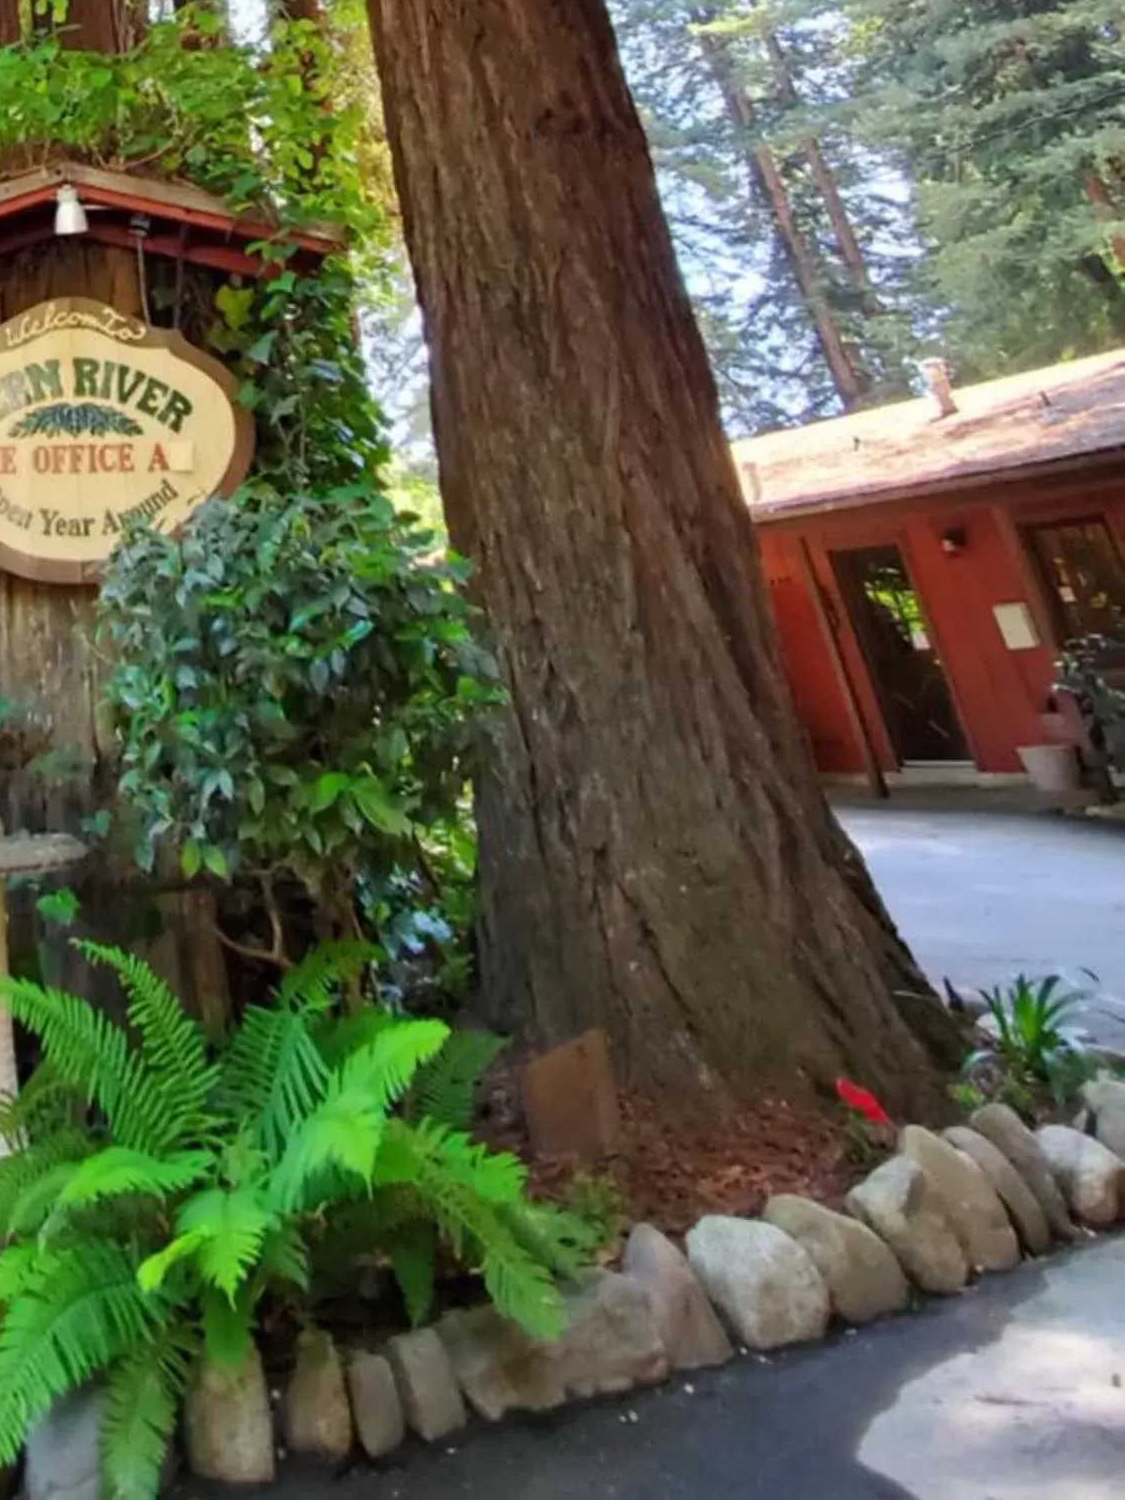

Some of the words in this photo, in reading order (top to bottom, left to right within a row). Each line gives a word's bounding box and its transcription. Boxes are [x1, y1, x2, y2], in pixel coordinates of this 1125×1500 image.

[72, 357, 193, 434] RIVER
[33, 443, 135, 474] OFFICE
[38, 507, 96, 537] Year
